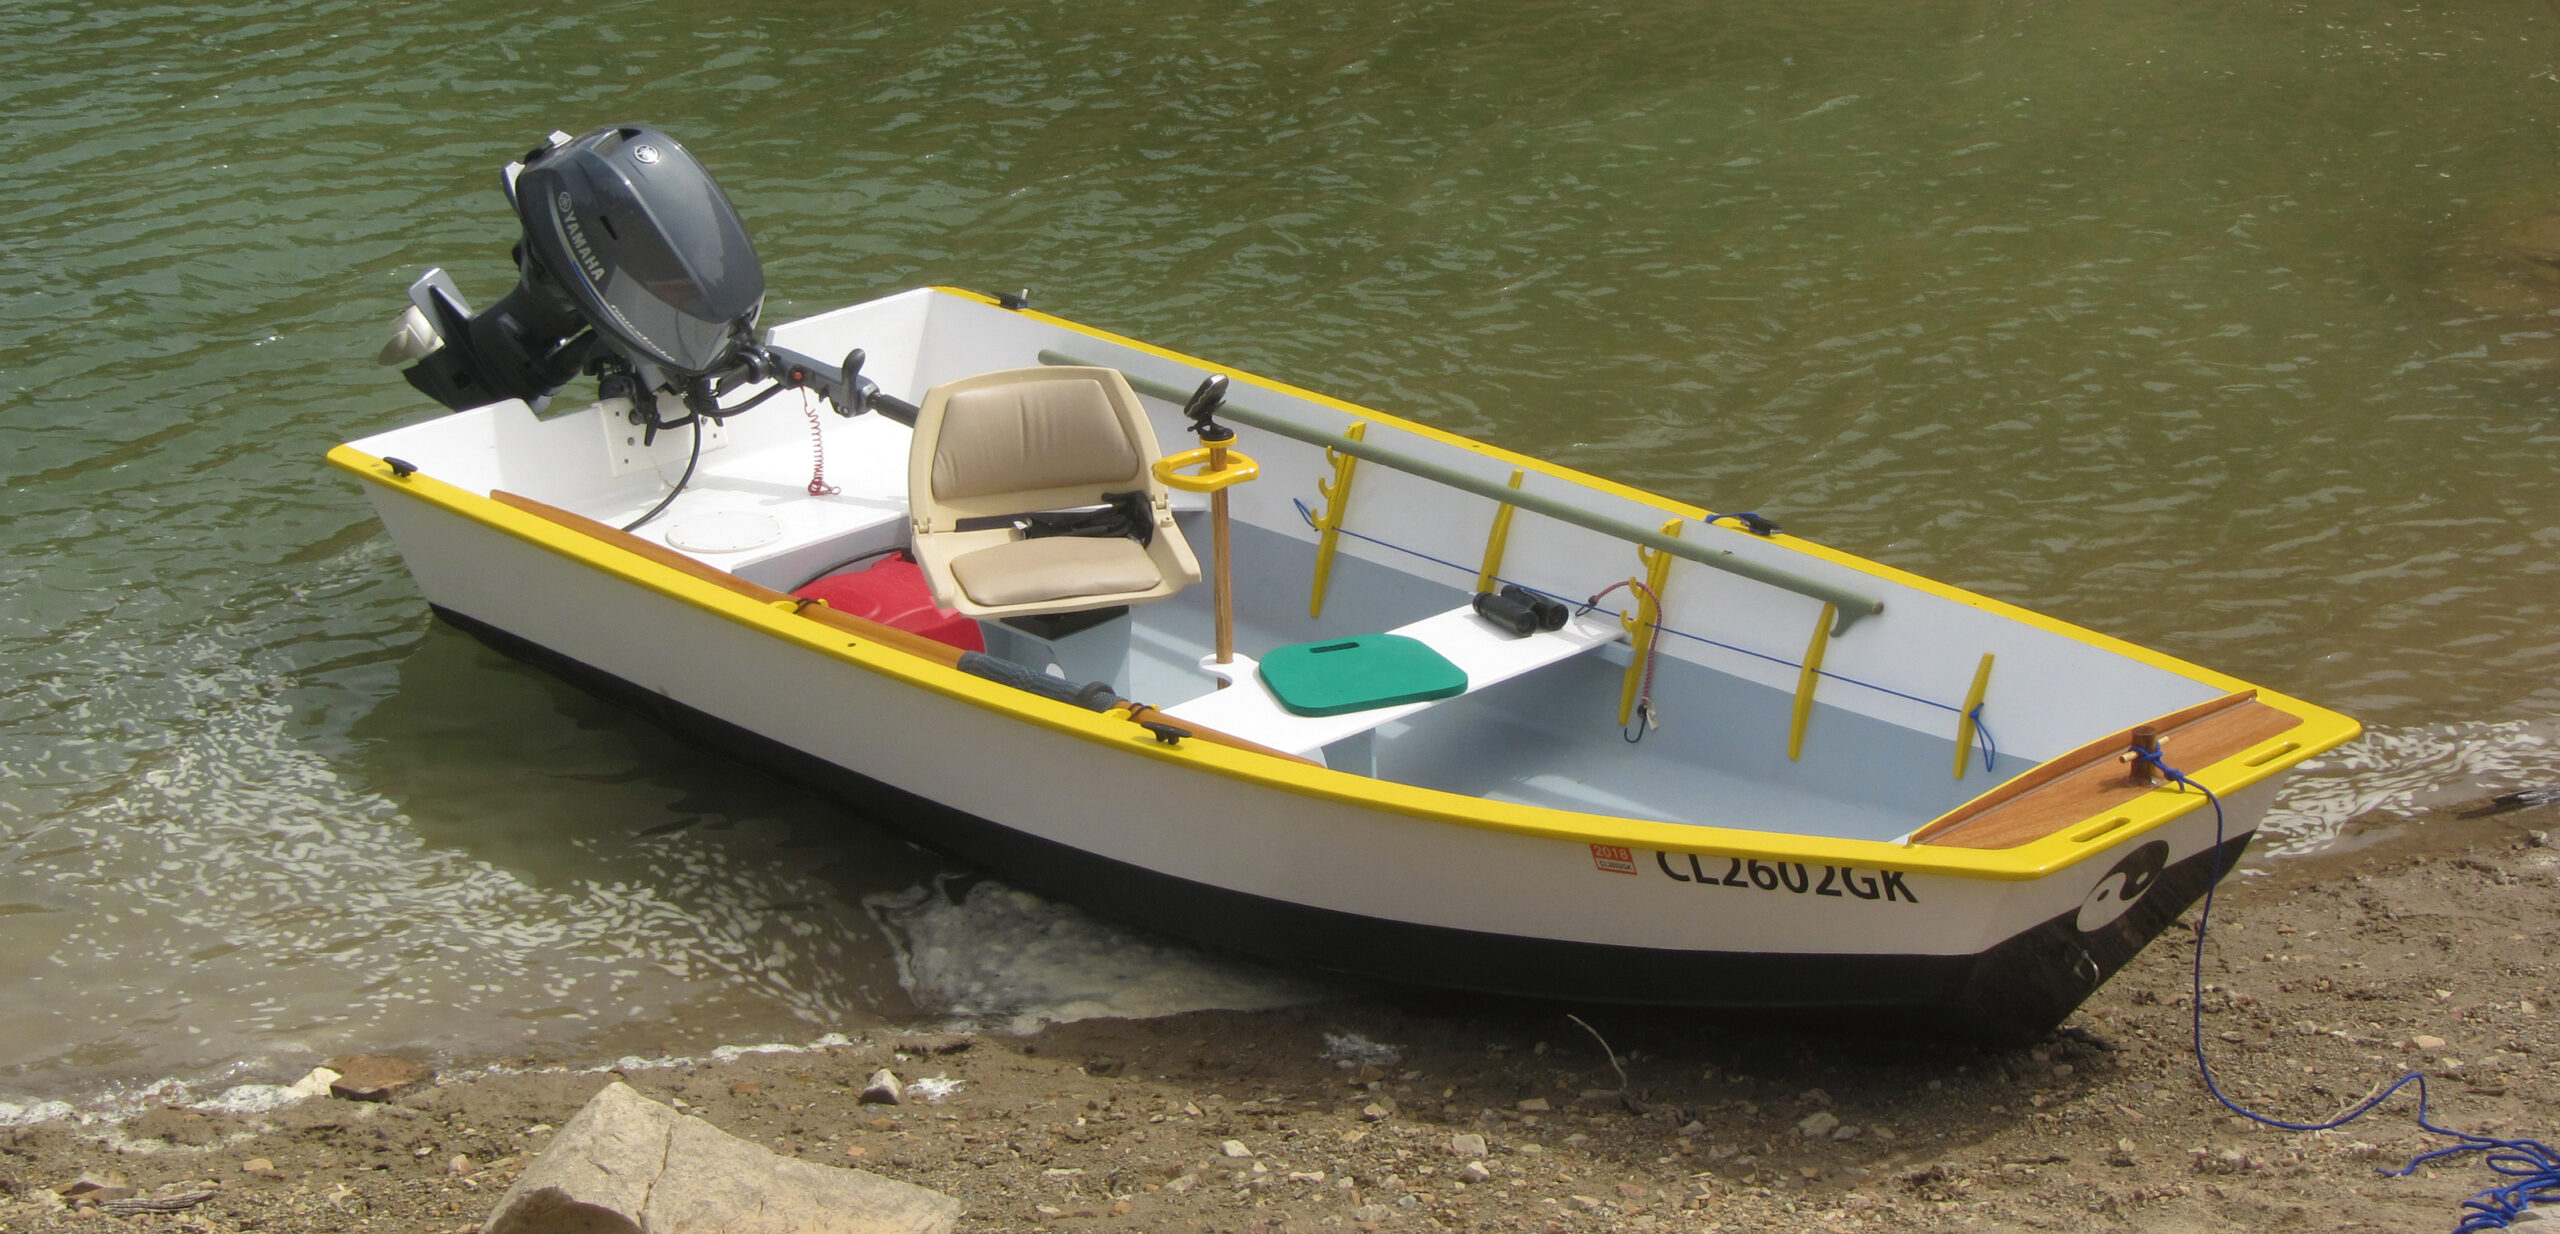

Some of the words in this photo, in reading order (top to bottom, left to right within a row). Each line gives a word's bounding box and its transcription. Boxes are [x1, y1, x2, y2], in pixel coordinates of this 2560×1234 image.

[564, 210, 605, 280] YAMAHA
[1593, 845, 1629, 860] 2018
[1656, 851, 1919, 903] CL2602GK
